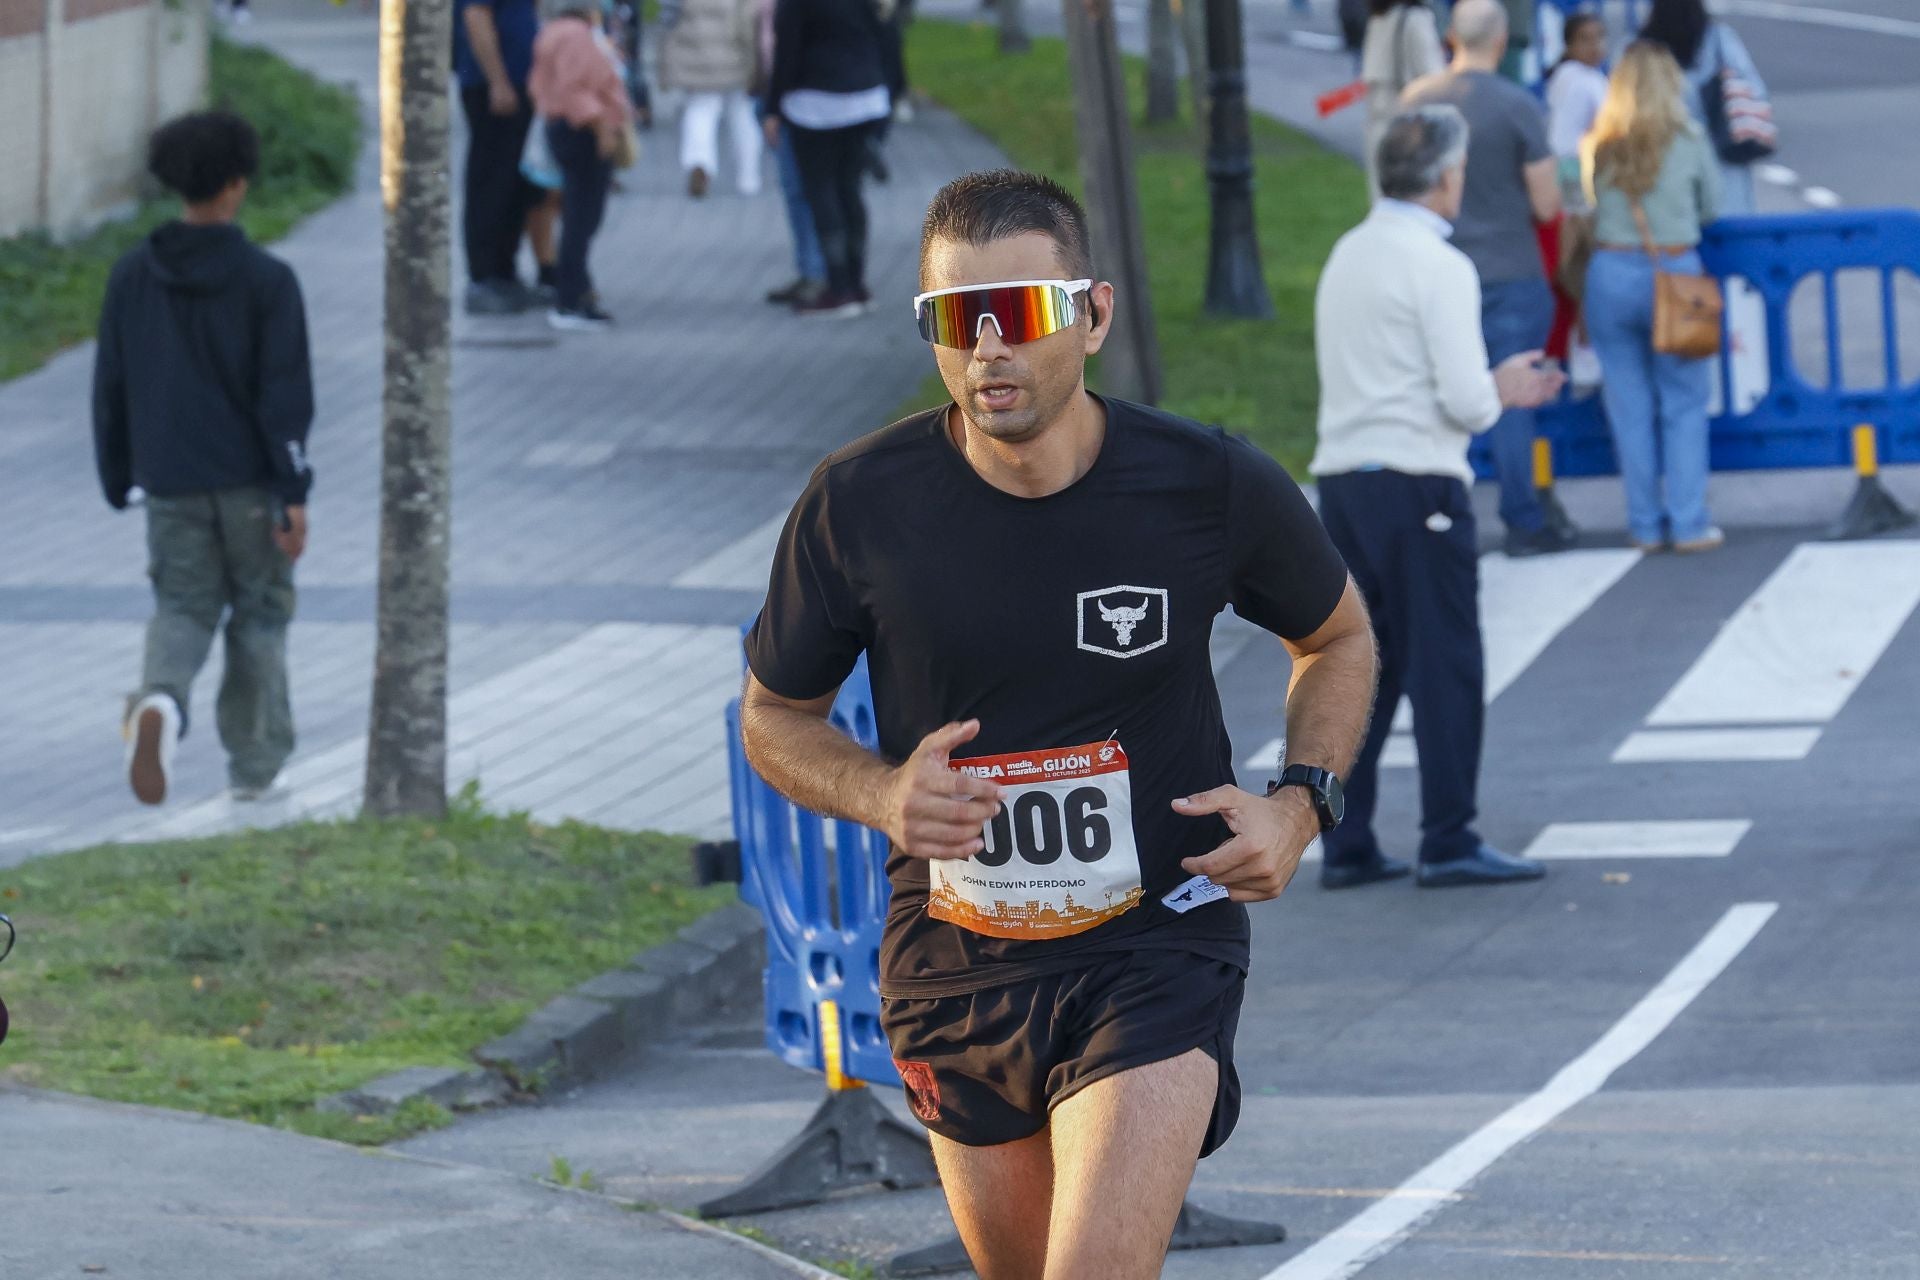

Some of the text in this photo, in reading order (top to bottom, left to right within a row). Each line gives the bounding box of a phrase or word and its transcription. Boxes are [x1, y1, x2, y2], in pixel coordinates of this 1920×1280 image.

[1007, 760, 1032, 770] media
[1043, 754, 1091, 772] GIJÓN
[951, 765, 1005, 778] MBA
[1008, 766, 1042, 776] maratón
[1052, 769, 1077, 777] OCTUBRE
[962, 786, 1112, 867] 006
[962, 875, 1086, 889] JOHN EDWIN PERDOMO
